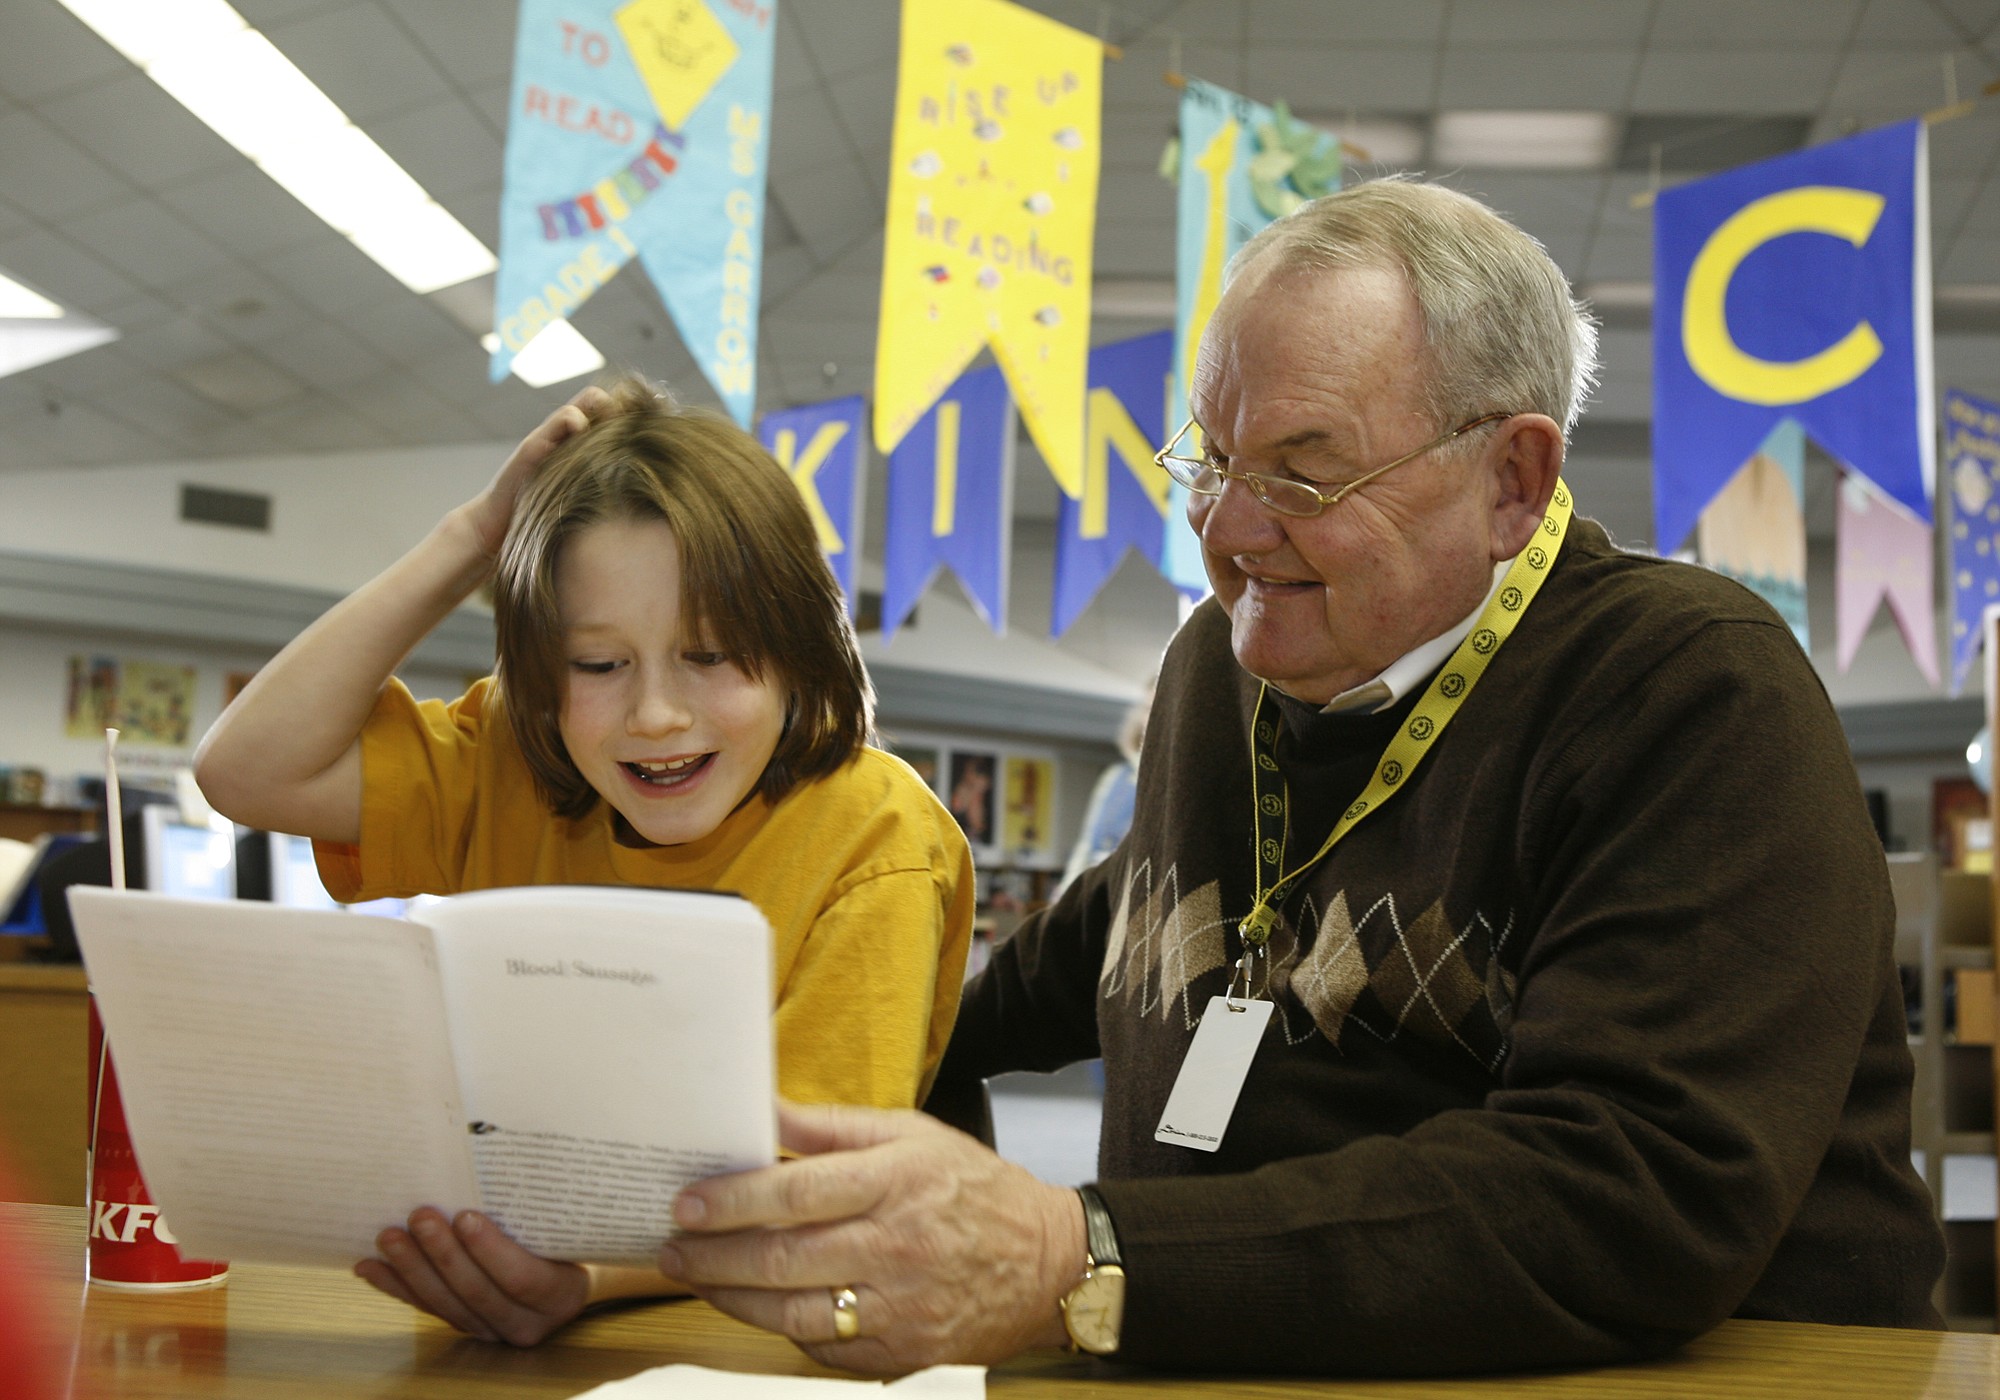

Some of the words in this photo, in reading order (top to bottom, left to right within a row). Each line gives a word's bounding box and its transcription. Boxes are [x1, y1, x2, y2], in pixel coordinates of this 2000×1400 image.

[560, 20, 611, 67] TO
[524, 85, 635, 145] READ
[502, 244, 620, 352] GRADE
[1681, 184, 1886, 408] C
[505, 958, 564, 977] Blood
[571, 960, 658, 986] Sausage
